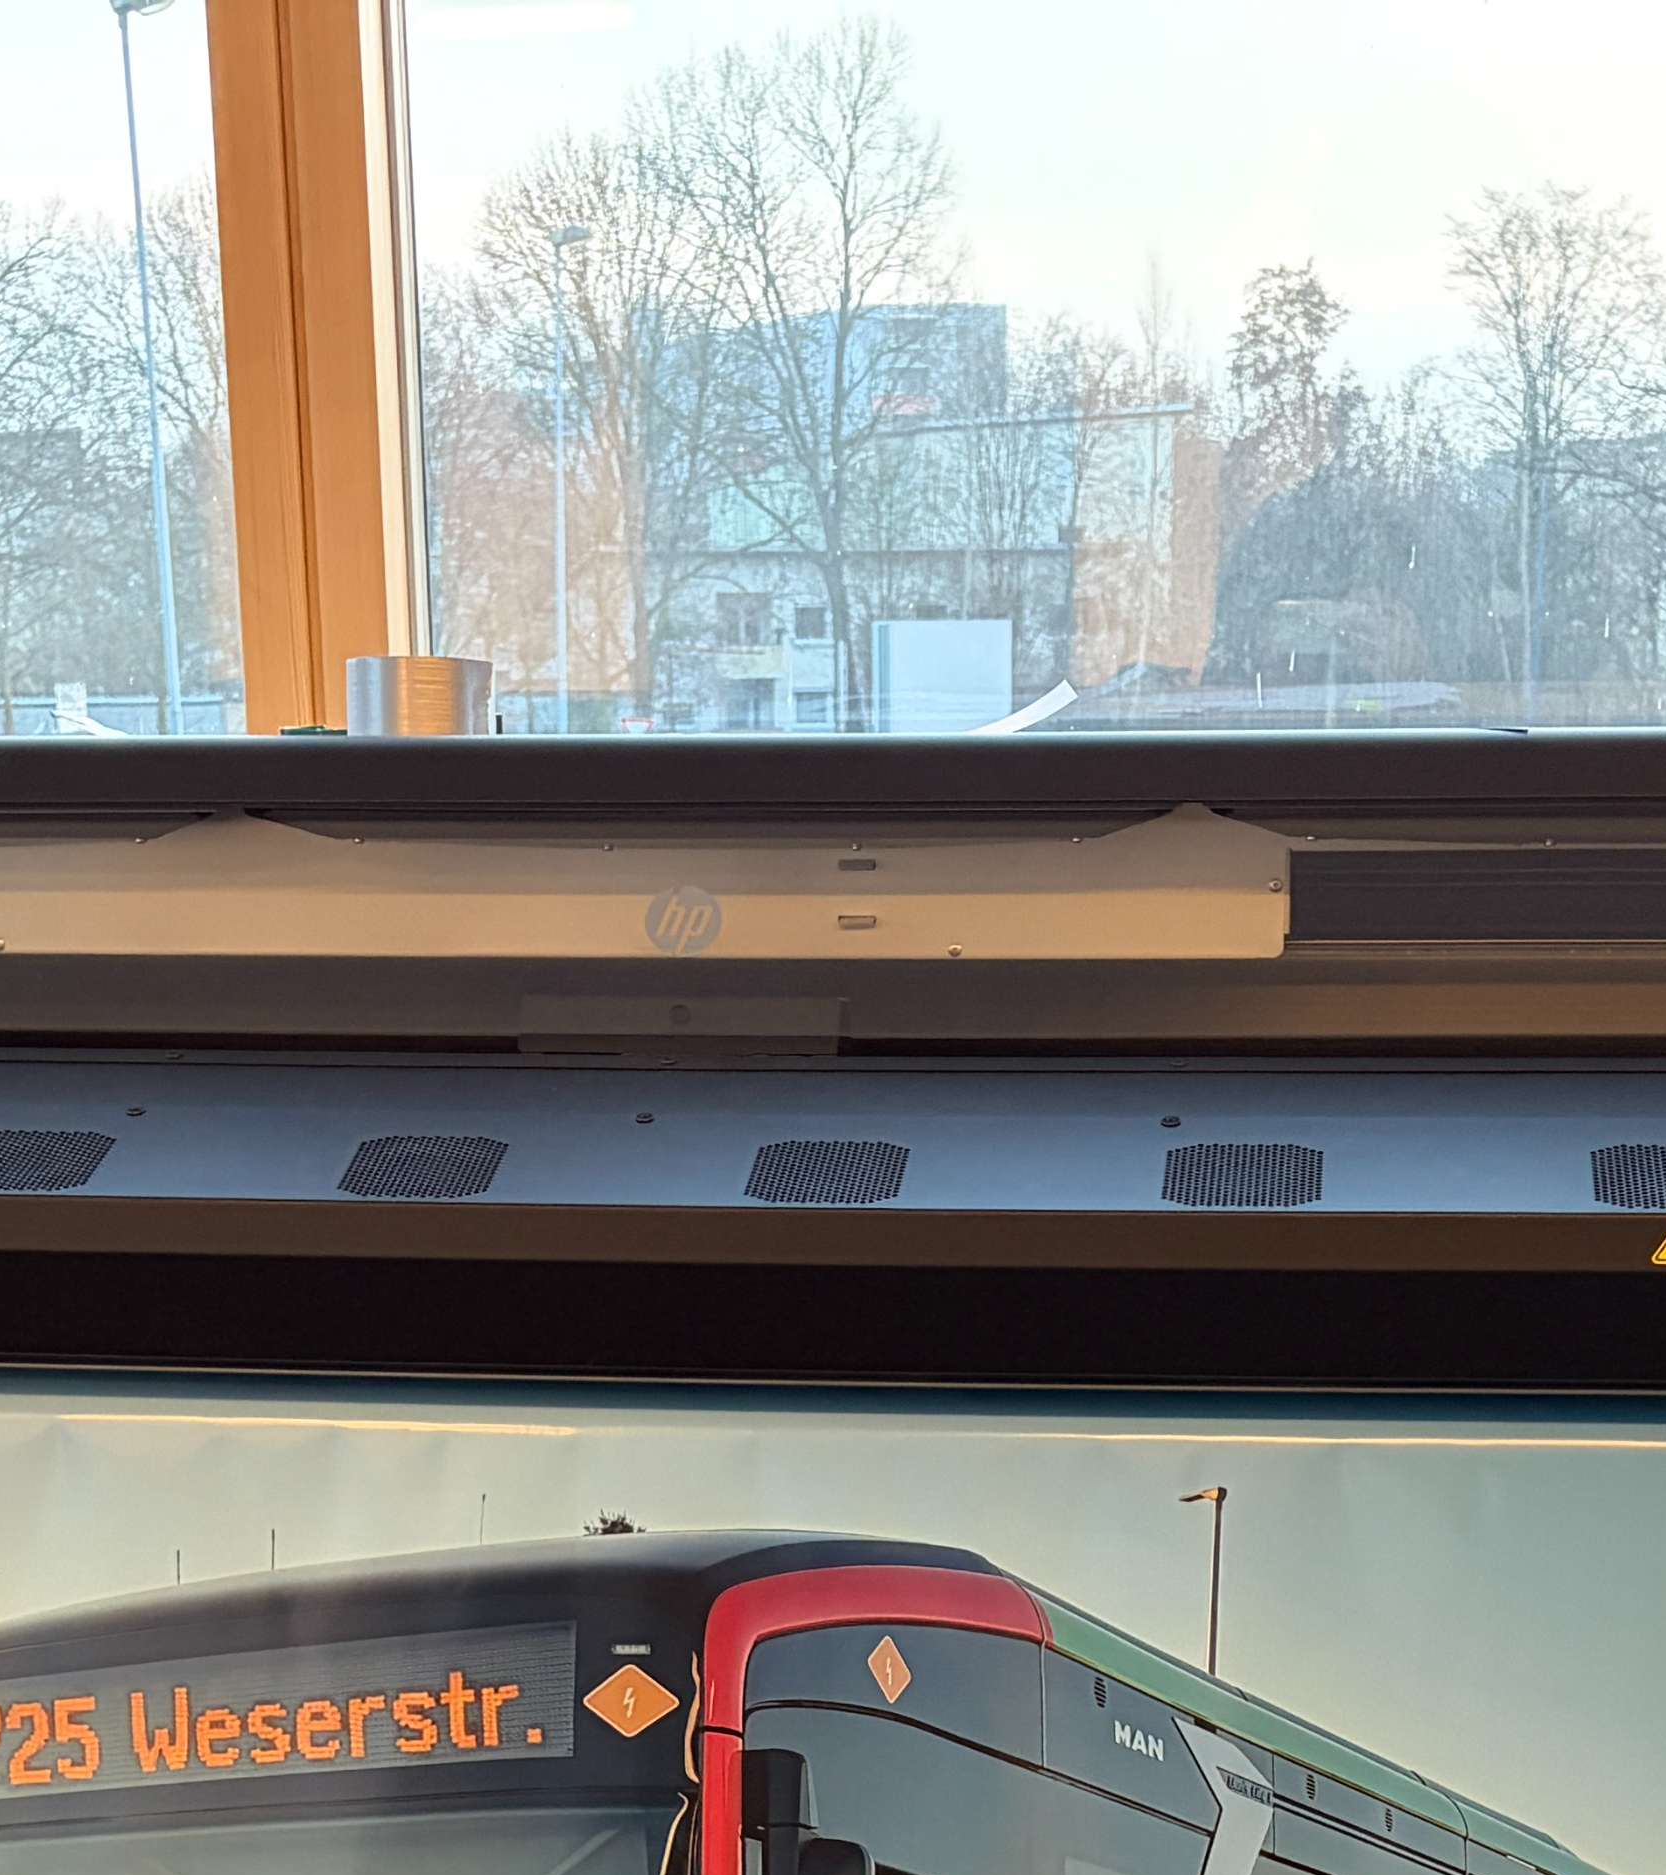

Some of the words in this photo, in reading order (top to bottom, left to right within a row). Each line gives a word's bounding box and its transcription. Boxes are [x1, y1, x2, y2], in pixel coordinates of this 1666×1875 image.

[652, 888, 716, 957] hp
[130, 1671, 543, 1772] Weserstr.
[1114, 1719, 1164, 1761] MAN
